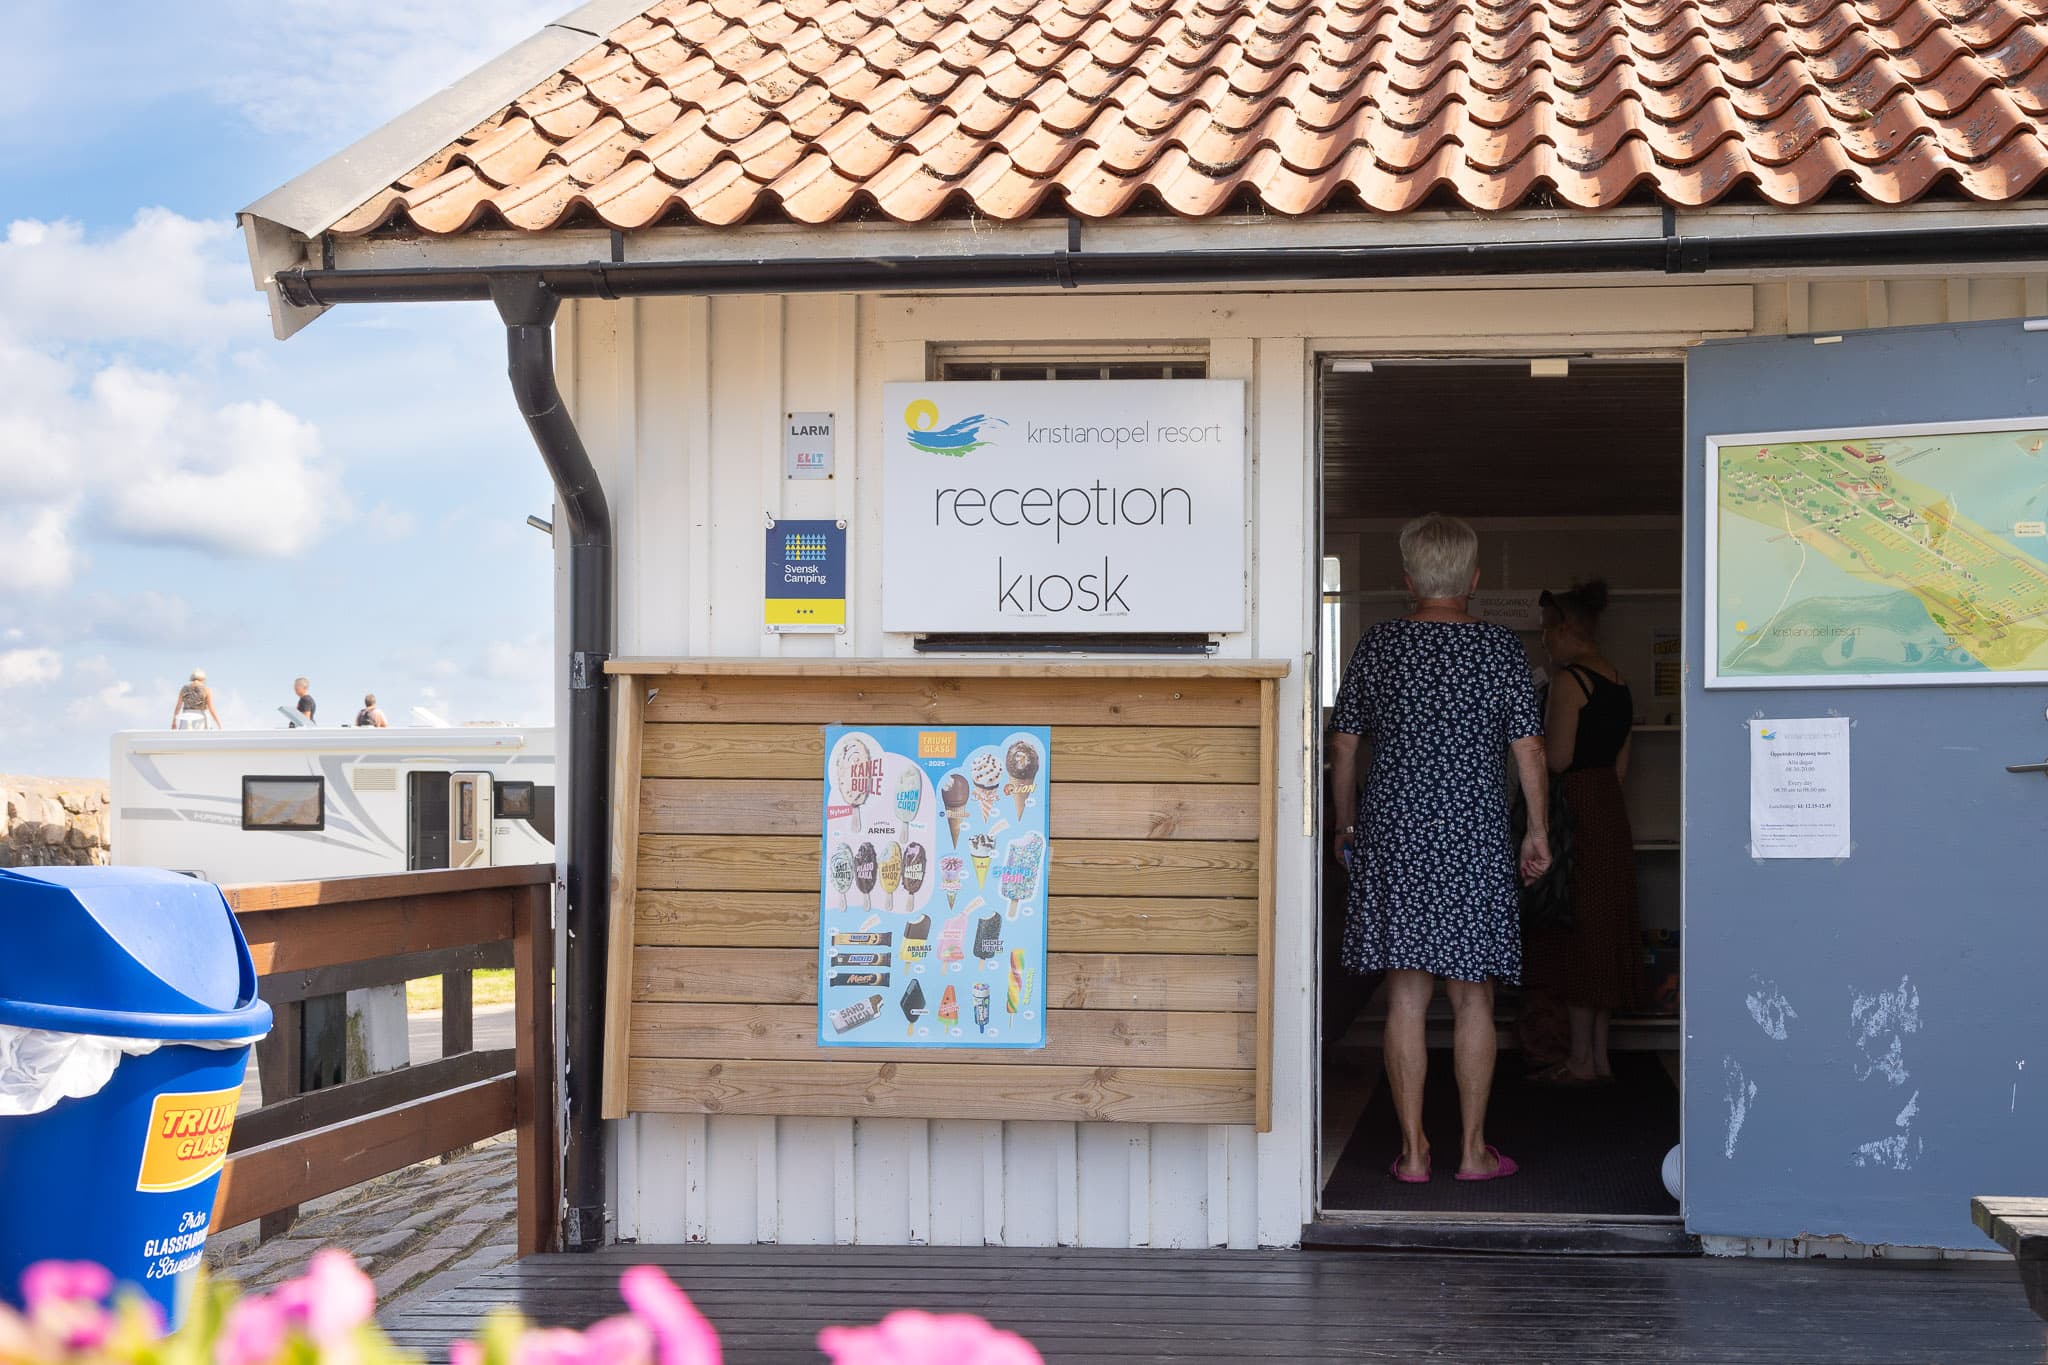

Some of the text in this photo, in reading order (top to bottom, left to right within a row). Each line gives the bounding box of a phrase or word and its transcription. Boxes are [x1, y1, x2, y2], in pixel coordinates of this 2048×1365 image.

[791, 425, 830, 436] LARM
[1027, 420, 1222, 449] kristianopel resort
[797, 452, 824, 464] ELIT
[935, 479, 1193, 544] reception
[784, 564, 819, 574] Svensk
[784, 574, 827, 585] Camping
[999, 555, 1131, 612] kiosk
[850, 758, 884, 778] KANEL
[851, 778, 883, 796] BULLE
[896, 789, 919, 801] LEMON
[897, 800, 917, 813] CURD
[907, 944, 932, 952] ANANAS
[839, 1003, 865, 1019] SAND
[162, 1101, 238, 1138] TRIUM
[146, 1262, 156, 1279] i
